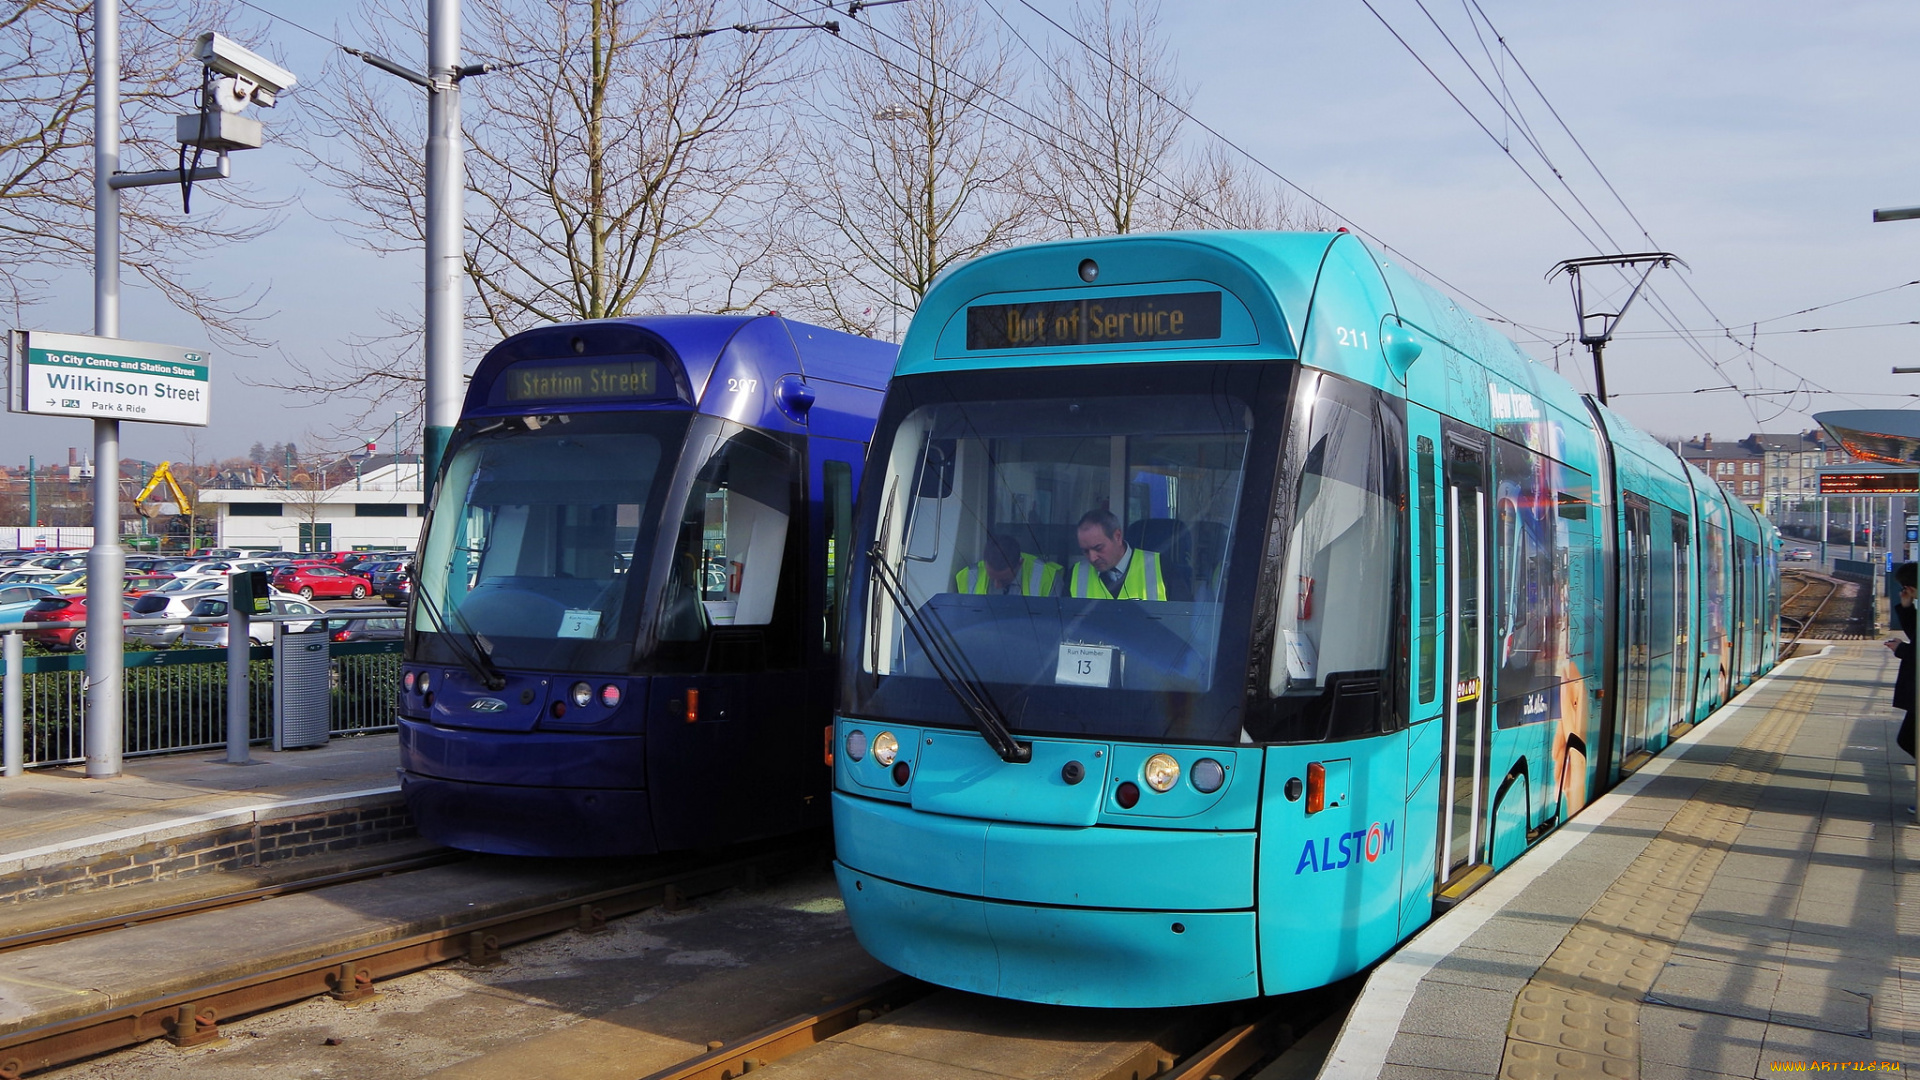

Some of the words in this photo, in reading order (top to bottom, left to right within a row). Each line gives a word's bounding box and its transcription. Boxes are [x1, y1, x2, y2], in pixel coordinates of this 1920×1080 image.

[1007, 308, 1046, 343] Out
[1055, 307, 1080, 340] of
[1089, 302, 1184, 339] Service
[1336, 326, 1368, 351] 211
[46, 353, 60, 363] To
[62, 354, 83, 366] City
[85, 356, 119, 368] Centre
[120, 361, 139, 370] and
[140, 362, 172, 374] Station
[172, 366, 195, 377] Street
[46, 372, 148, 397] Wilkinson
[154, 382, 200, 402] Street
[523, 371, 582, 397] Station
[590, 367, 648, 394] Street
[727, 378, 758, 393] 207
[92, 401, 114, 411] Park
[116, 403, 123, 412] &
[126, 404, 146, 414] Ride
[573, 622, 582, 631] 3
[1077, 660, 1092, 674] 13
[471, 700, 503, 710] NET
[1295, 819, 1394, 875] ALSTOM
